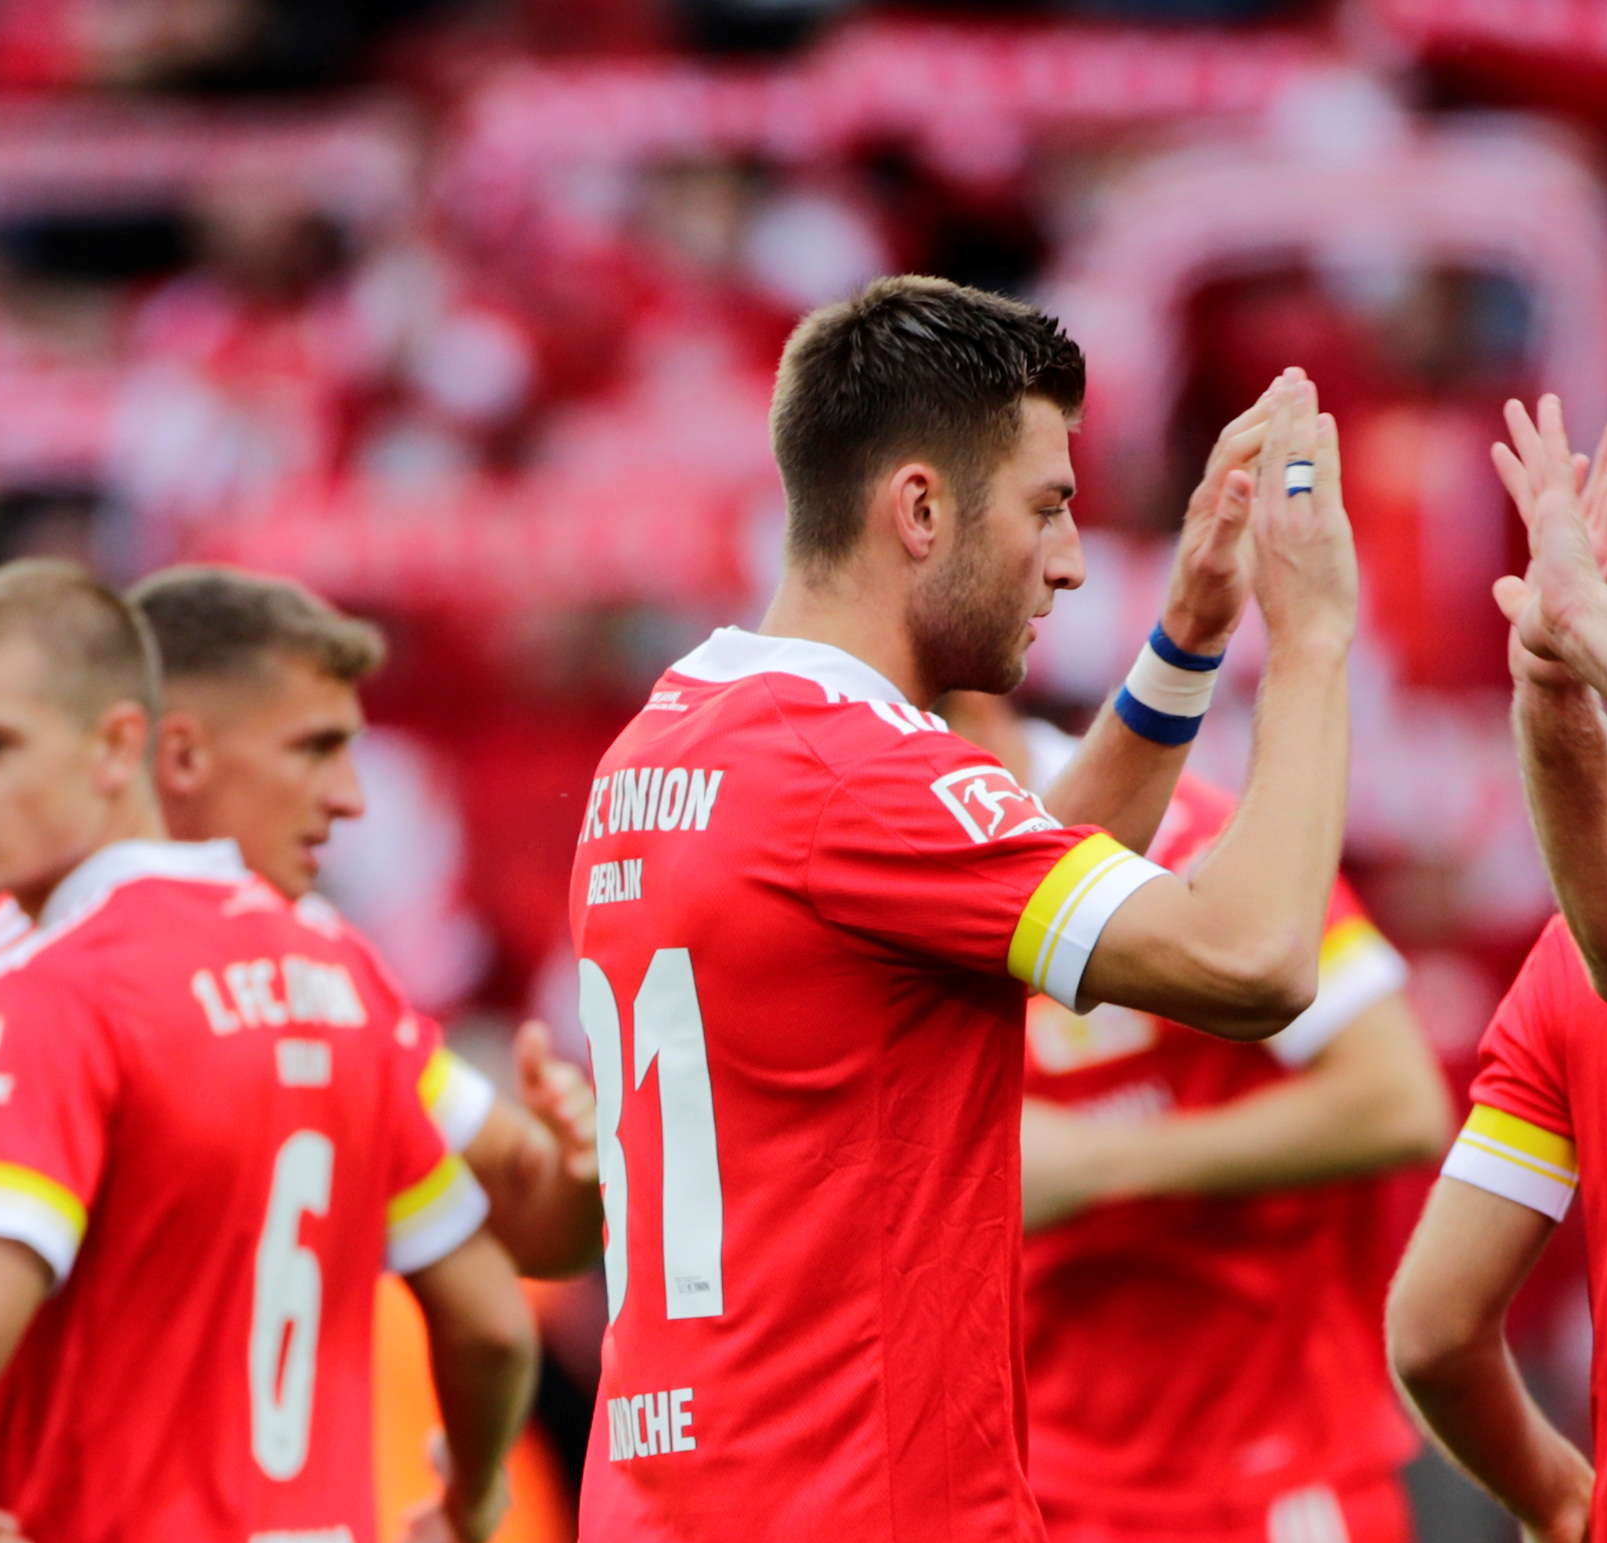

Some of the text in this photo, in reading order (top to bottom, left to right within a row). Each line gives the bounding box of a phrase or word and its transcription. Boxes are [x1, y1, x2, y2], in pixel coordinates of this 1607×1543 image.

[608, 766, 725, 835] UNION
[586, 857, 643, 907] BERLIN
[248, 1129, 335, 1482] 6
